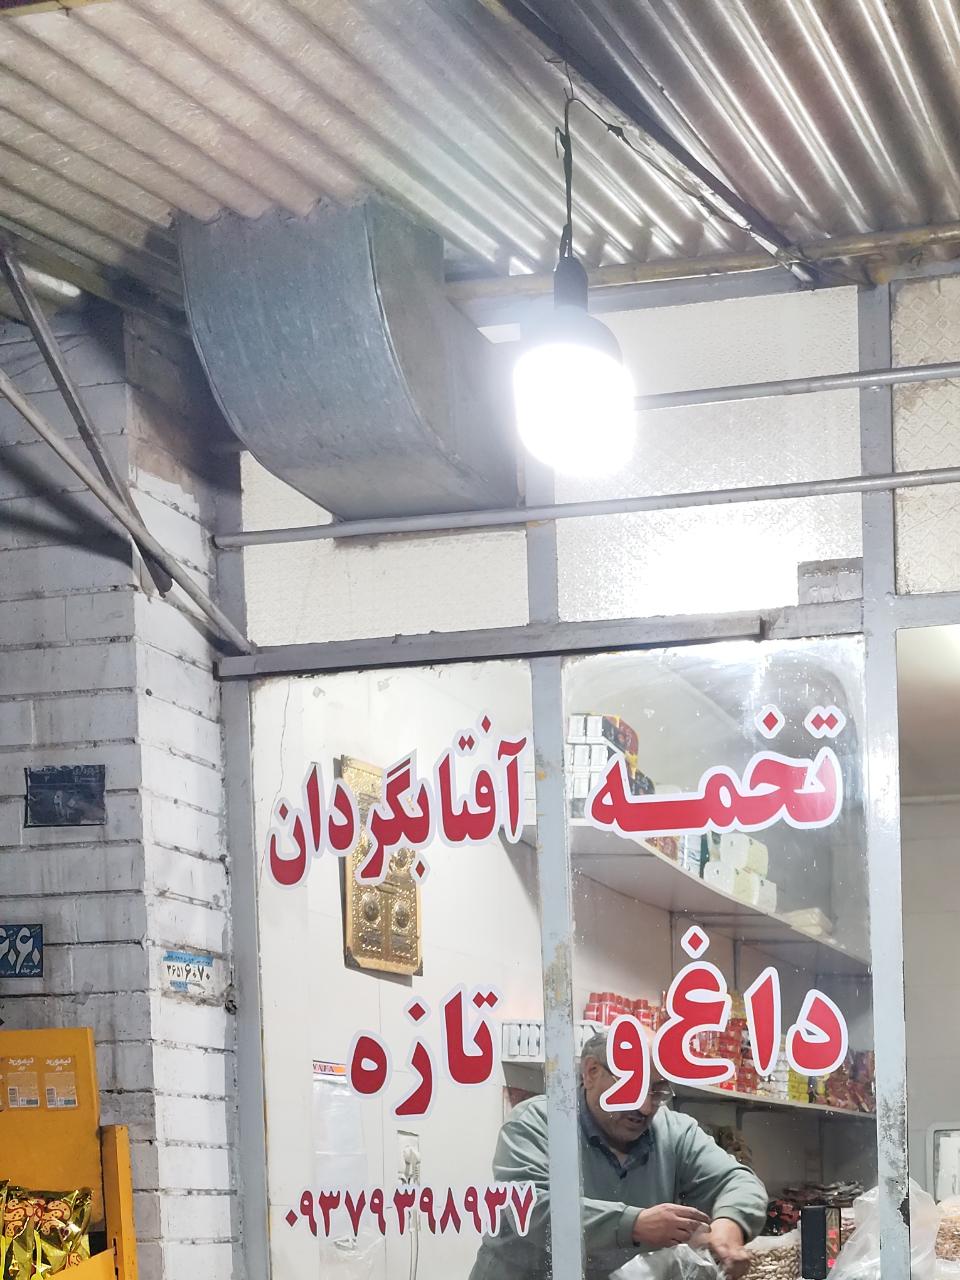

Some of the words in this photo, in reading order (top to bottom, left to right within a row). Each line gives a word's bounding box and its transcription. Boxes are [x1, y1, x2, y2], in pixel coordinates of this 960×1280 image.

[269, 714, 527, 886] آفتابگردان
[590, 710, 837, 832] تخمه
[350, 990, 499, 1117] تازه
[603, 1019, 645, 1105] و
[656, 932, 843, 1080] داغ
[285, 1185, 534, 1237] ۰۹۳۷۹۳۹۸۹۳۷
